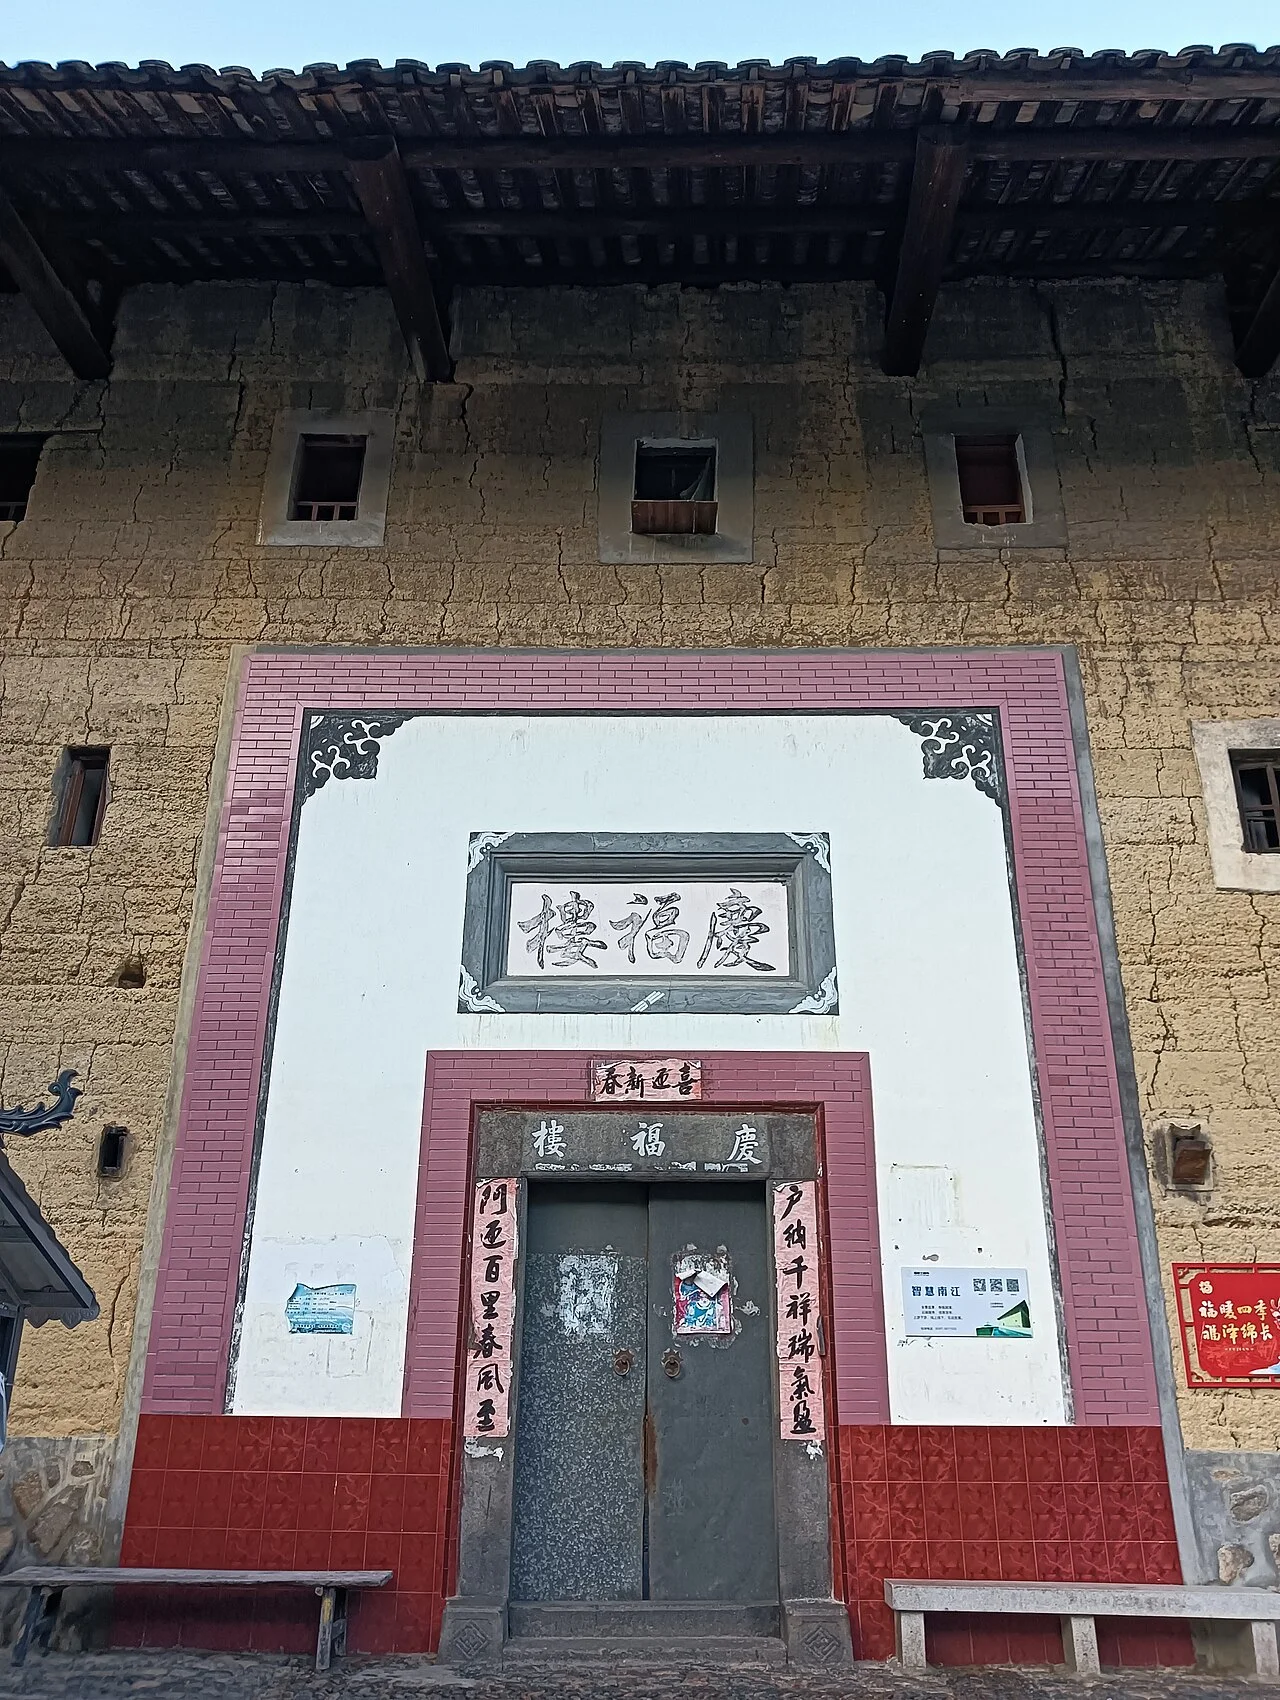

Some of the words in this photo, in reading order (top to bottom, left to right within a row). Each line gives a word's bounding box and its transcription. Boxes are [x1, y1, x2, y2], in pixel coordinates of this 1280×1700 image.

[911, 1285, 961, 1297] 智慧南江
[1198, 1300, 1268, 1321] 福暖四季
[1202, 1322, 1273, 1344] 福泽绵长
